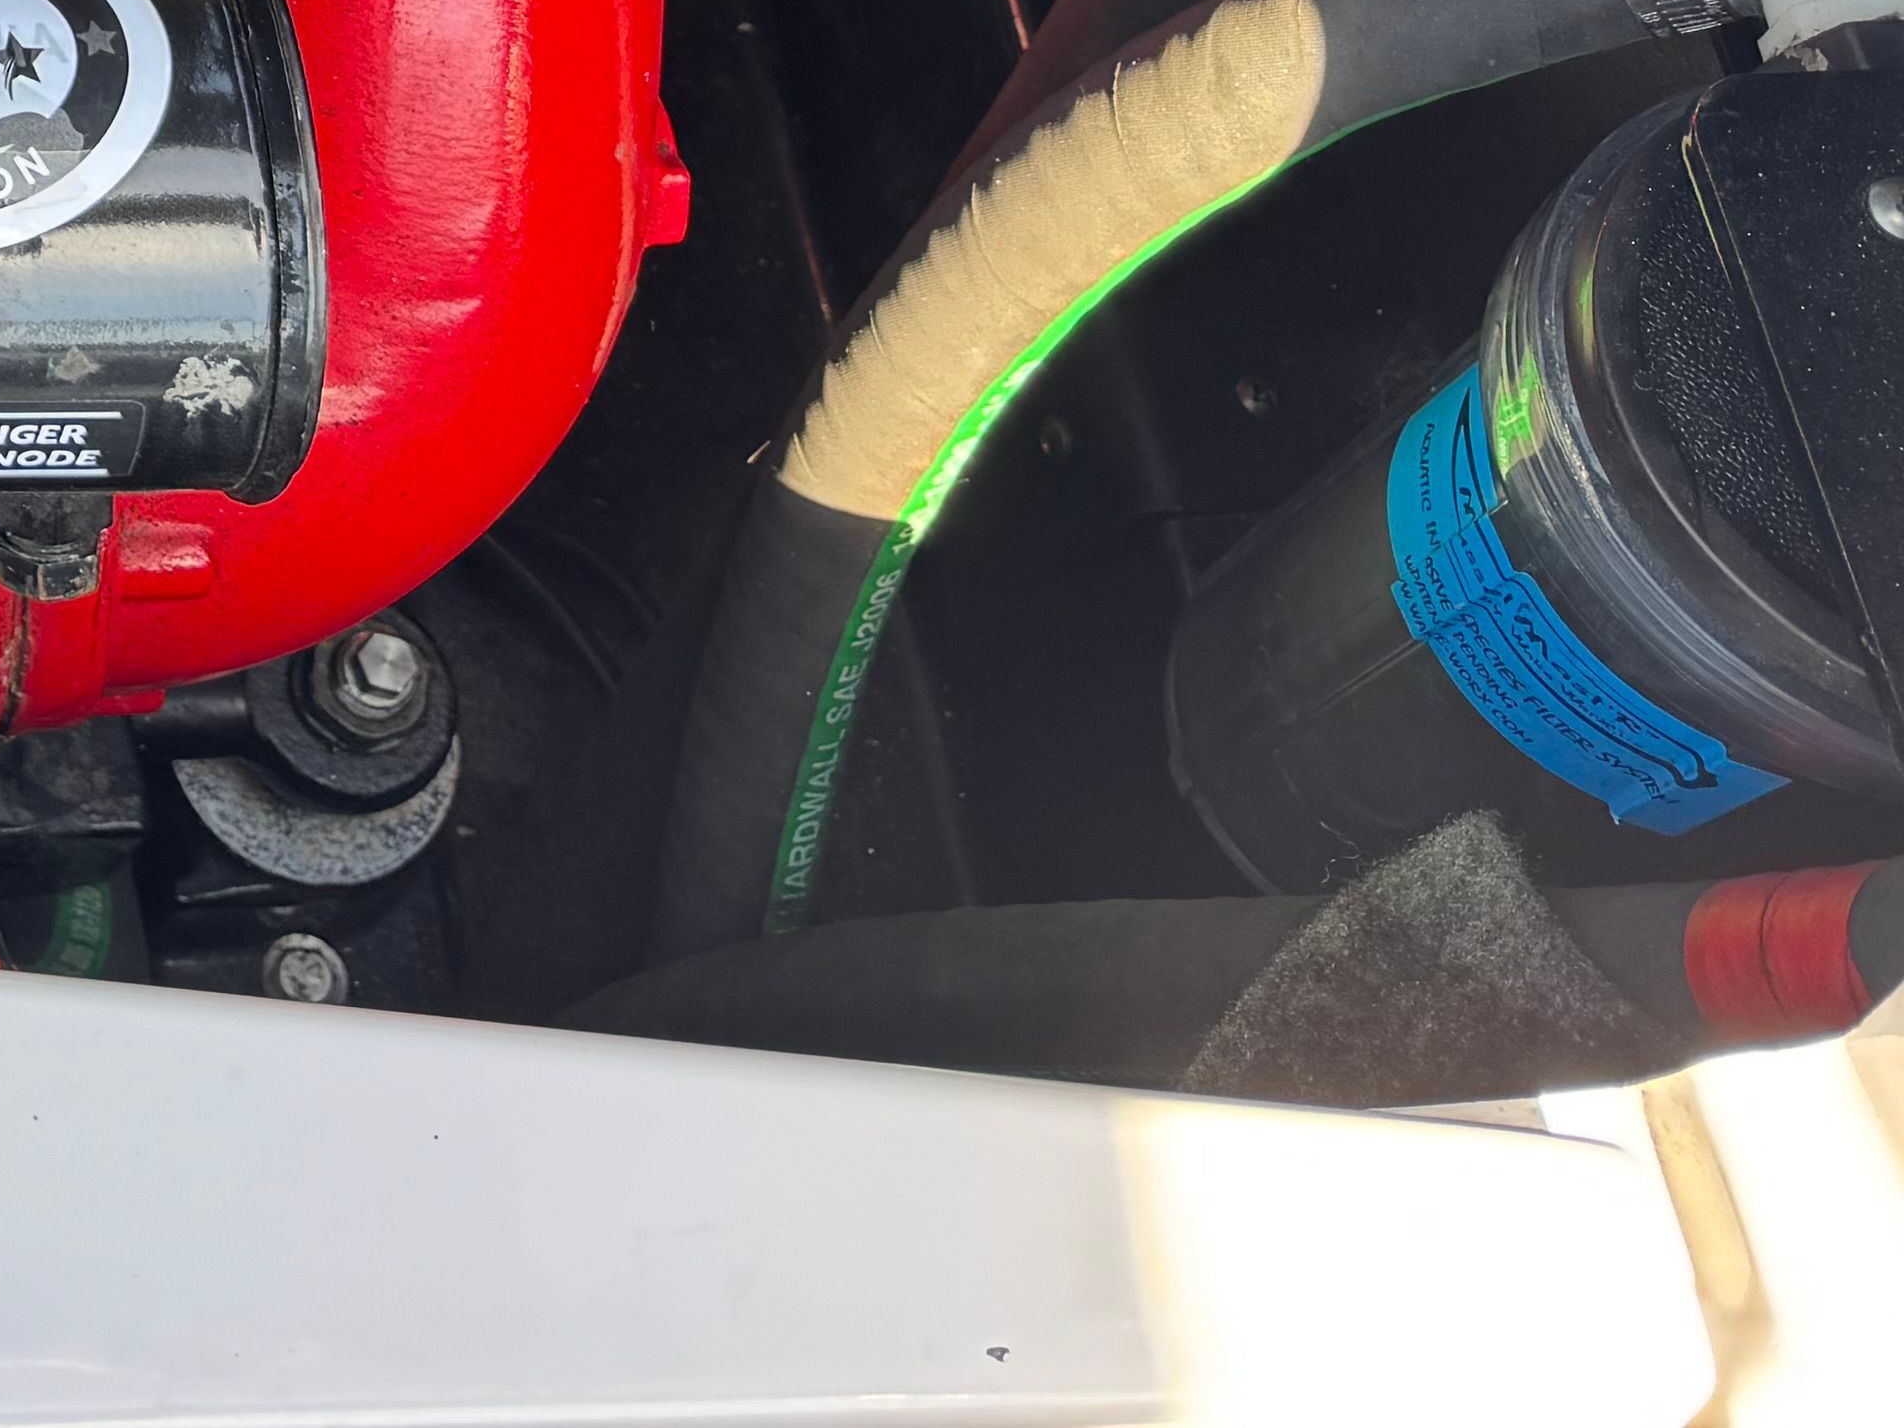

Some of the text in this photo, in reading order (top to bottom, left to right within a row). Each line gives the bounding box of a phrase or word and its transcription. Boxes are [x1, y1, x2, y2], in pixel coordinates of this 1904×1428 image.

[1424, 522, 1455, 612] INASIVE
[1458, 612, 1523, 692] SPECIES
[1522, 693, 1594, 751] FILTER
[1452, 629, 1519, 710] PENDING
[826, 663, 864, 723] SAE
